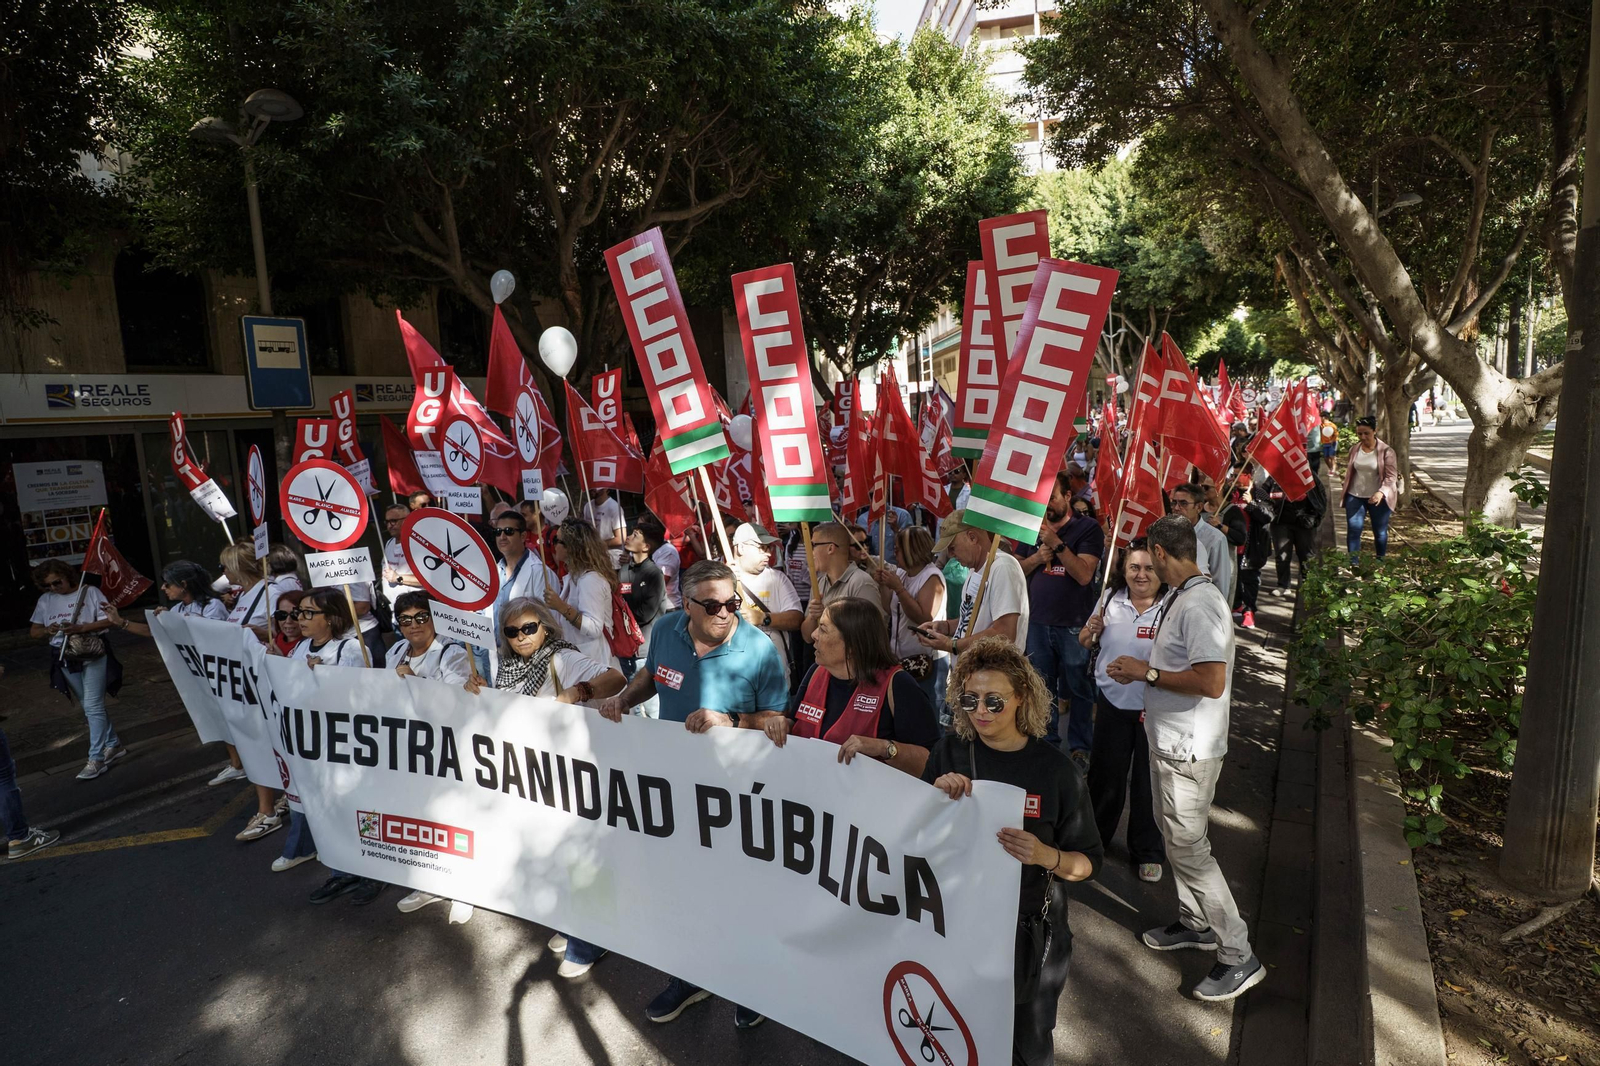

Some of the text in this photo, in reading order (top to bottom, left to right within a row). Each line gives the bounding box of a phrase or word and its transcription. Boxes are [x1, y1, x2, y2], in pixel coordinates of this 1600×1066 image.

[616, 240, 706, 431] CCOO
[743, 276, 814, 479] CCOO
[990, 270, 1101, 494] CCOO
[79, 384, 150, 397] REALE
[81, 398, 152, 407] SEGUROS
[376, 394, 414, 402] SEGURO
[414, 372, 446, 450] UGT
[334, 395, 357, 462] UGT
[171, 417, 201, 485] UGT
[309, 555, 368, 569] MAREA BLANCA
[324, 566, 359, 579] ALMERÍA
[411, 531, 490, 592] MAREA BLANCA ALMERÍA
[433, 610, 491, 634] MAREA BLANCA
[447, 624, 481, 641] ALMERÍA
[656, 665, 683, 684] CCOO
[798, 703, 824, 719] CCOO
[280, 705, 463, 782] NUESTRA
[472, 733, 675, 838] SANIDAD
[695, 782, 946, 938] PÚBLICA
[386, 820, 449, 848] CCOO
[360, 837, 439, 860] federación de sanidad
[367, 849, 397, 862] sectores
[901, 978, 912, 1002] MAREA
[916, 1017, 935, 1042] BLANCA
